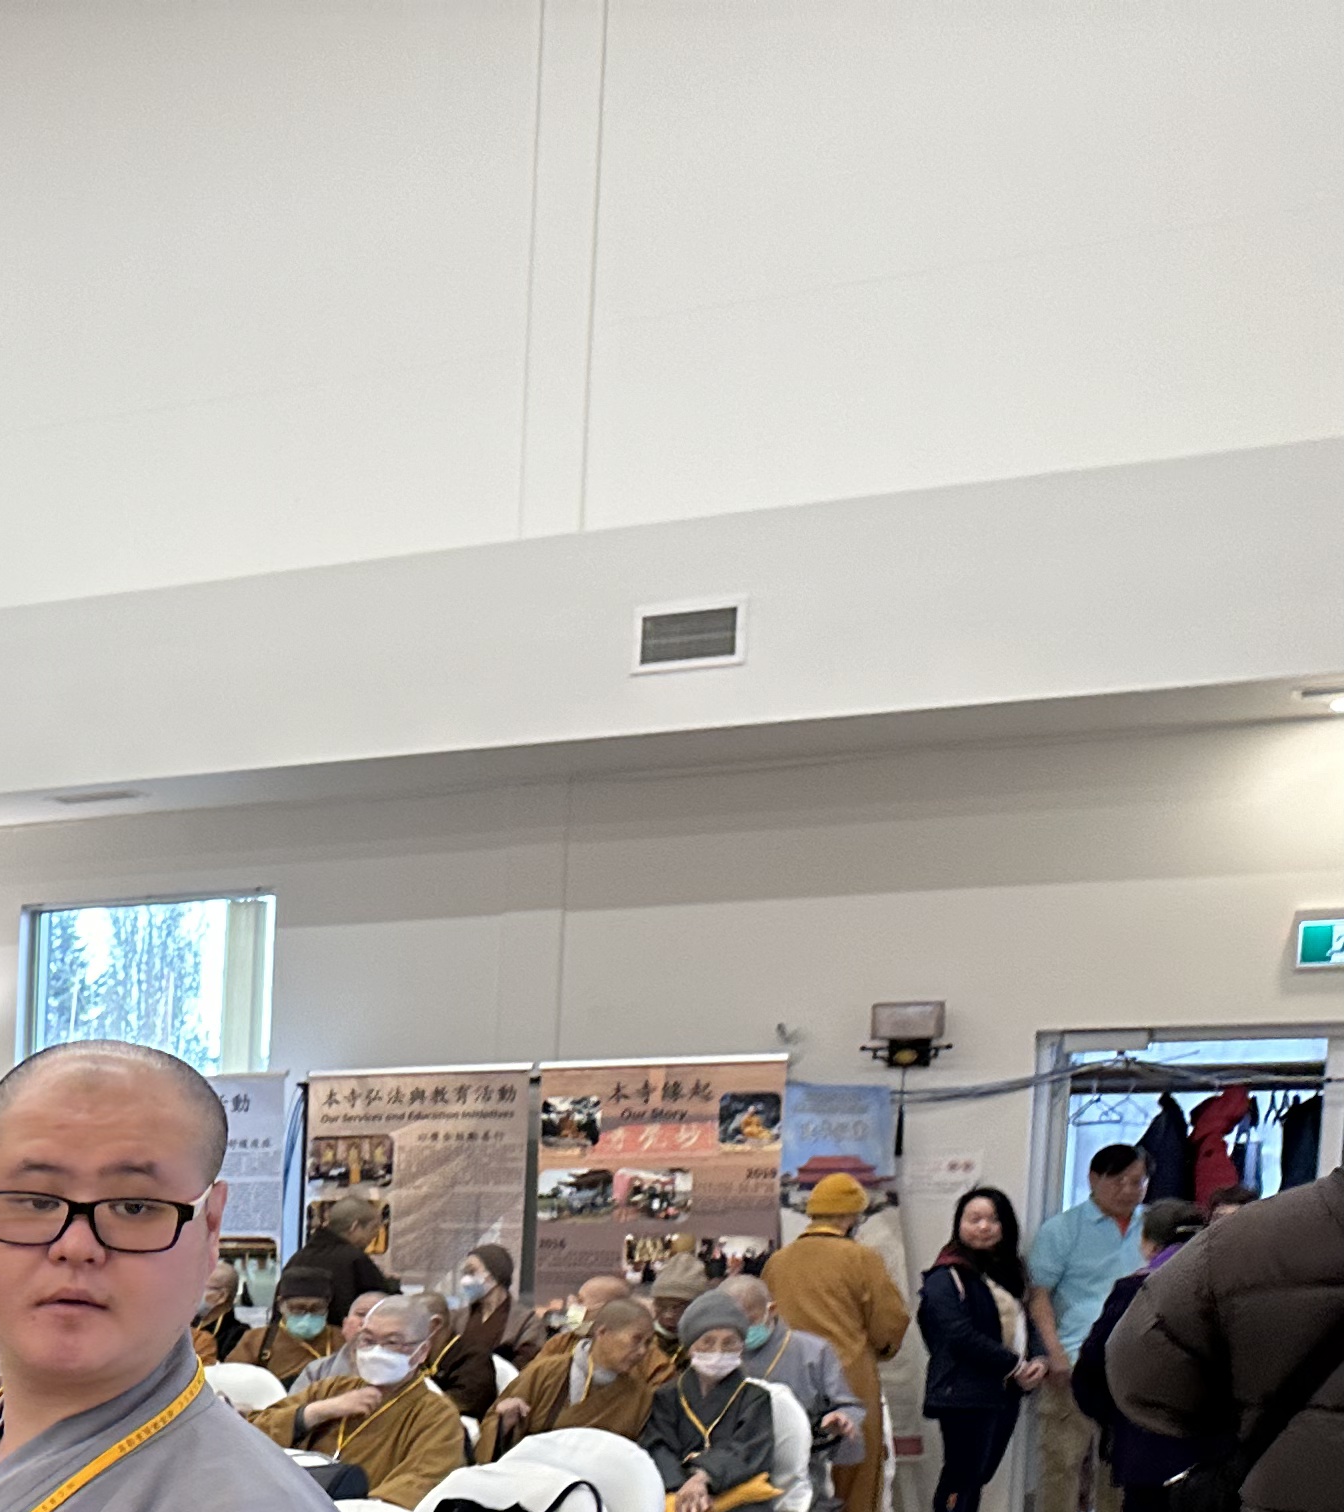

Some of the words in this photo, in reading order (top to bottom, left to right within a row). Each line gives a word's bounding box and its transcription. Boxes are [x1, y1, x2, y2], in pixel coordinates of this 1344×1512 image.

[320, 1114, 340, 1124] Our
[342, 1112, 383, 1123] Services
[385, 1111, 406, 1122] and
[408, 1110, 460, 1121] Education
[620, 1109, 648, 1121] Our
[651, 1108, 689, 1121] Story
